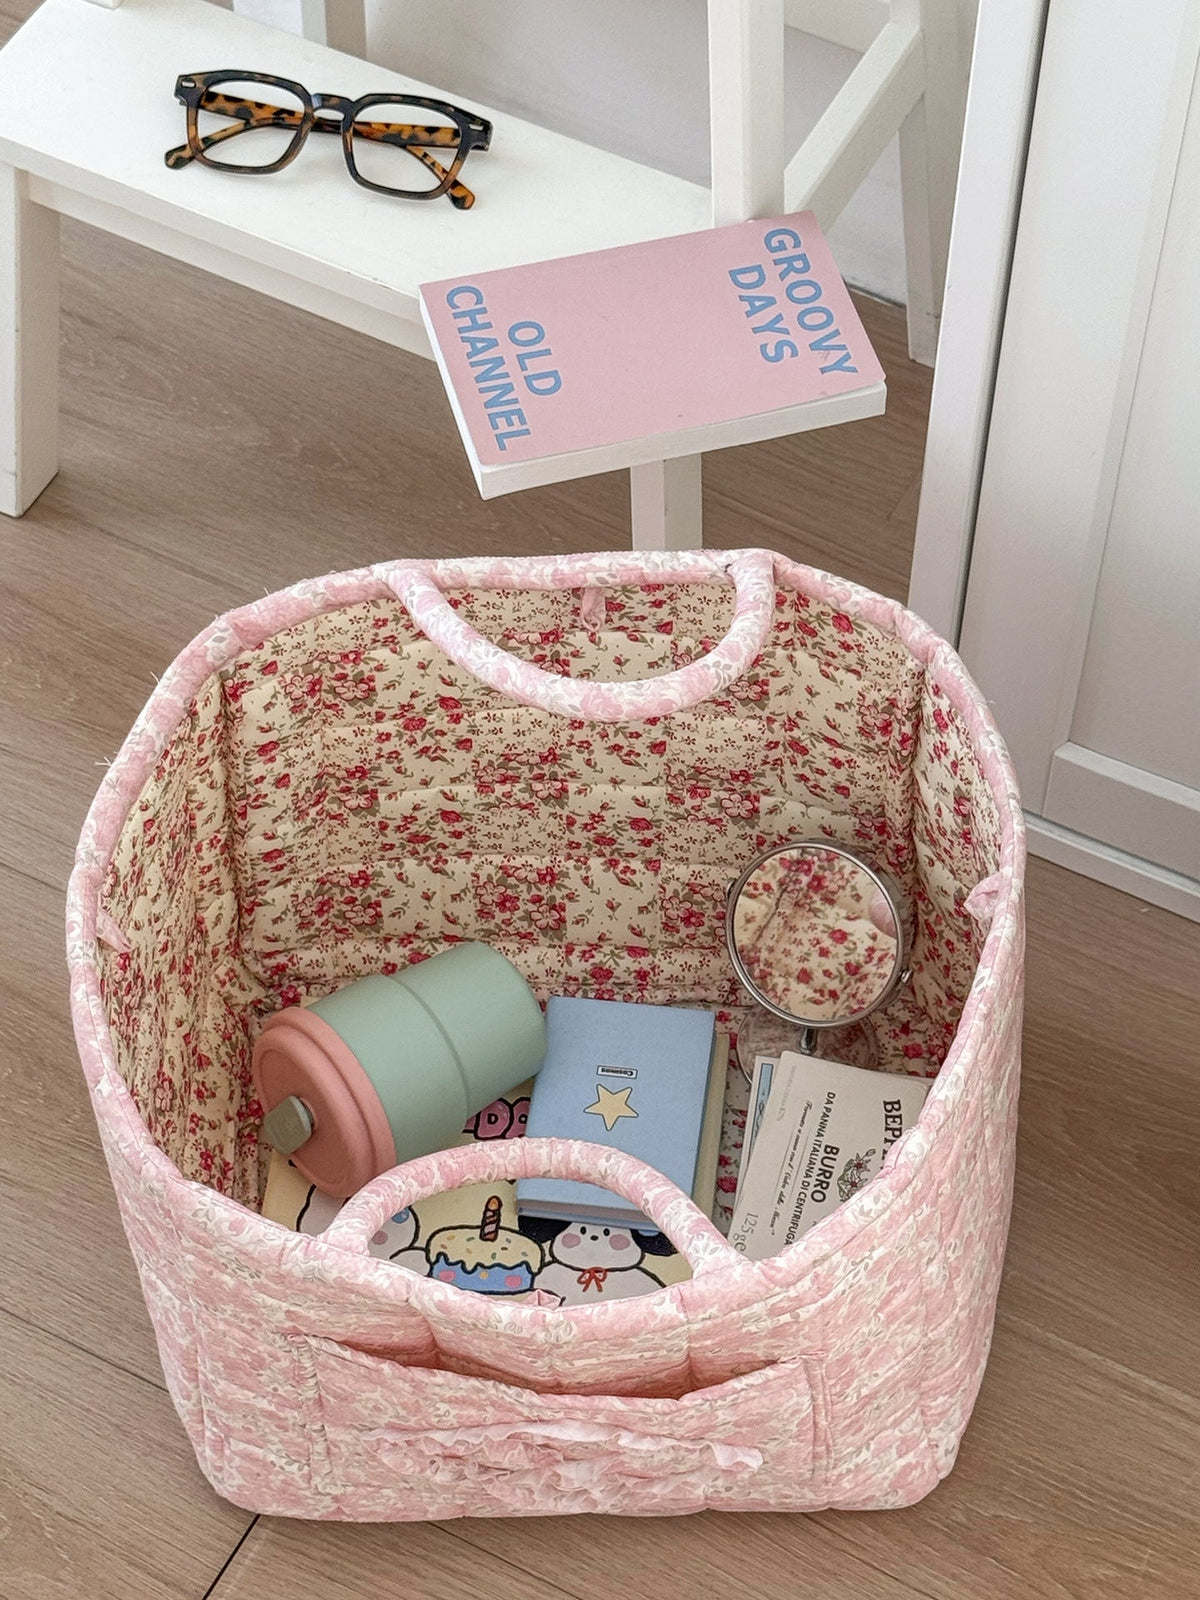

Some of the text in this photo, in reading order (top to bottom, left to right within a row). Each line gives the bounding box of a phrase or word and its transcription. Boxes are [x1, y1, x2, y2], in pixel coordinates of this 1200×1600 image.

[508, 320, 562, 397] OLD
[729, 264, 799, 363] DAYS
[764, 227, 858, 376] GROOVY
[446, 285, 531, 451] CHANNEL
[784, 1091, 836, 1245] DA PANNA ITALIANA DI CENTRIFUGA
[810, 1144, 840, 1203] BURRO
